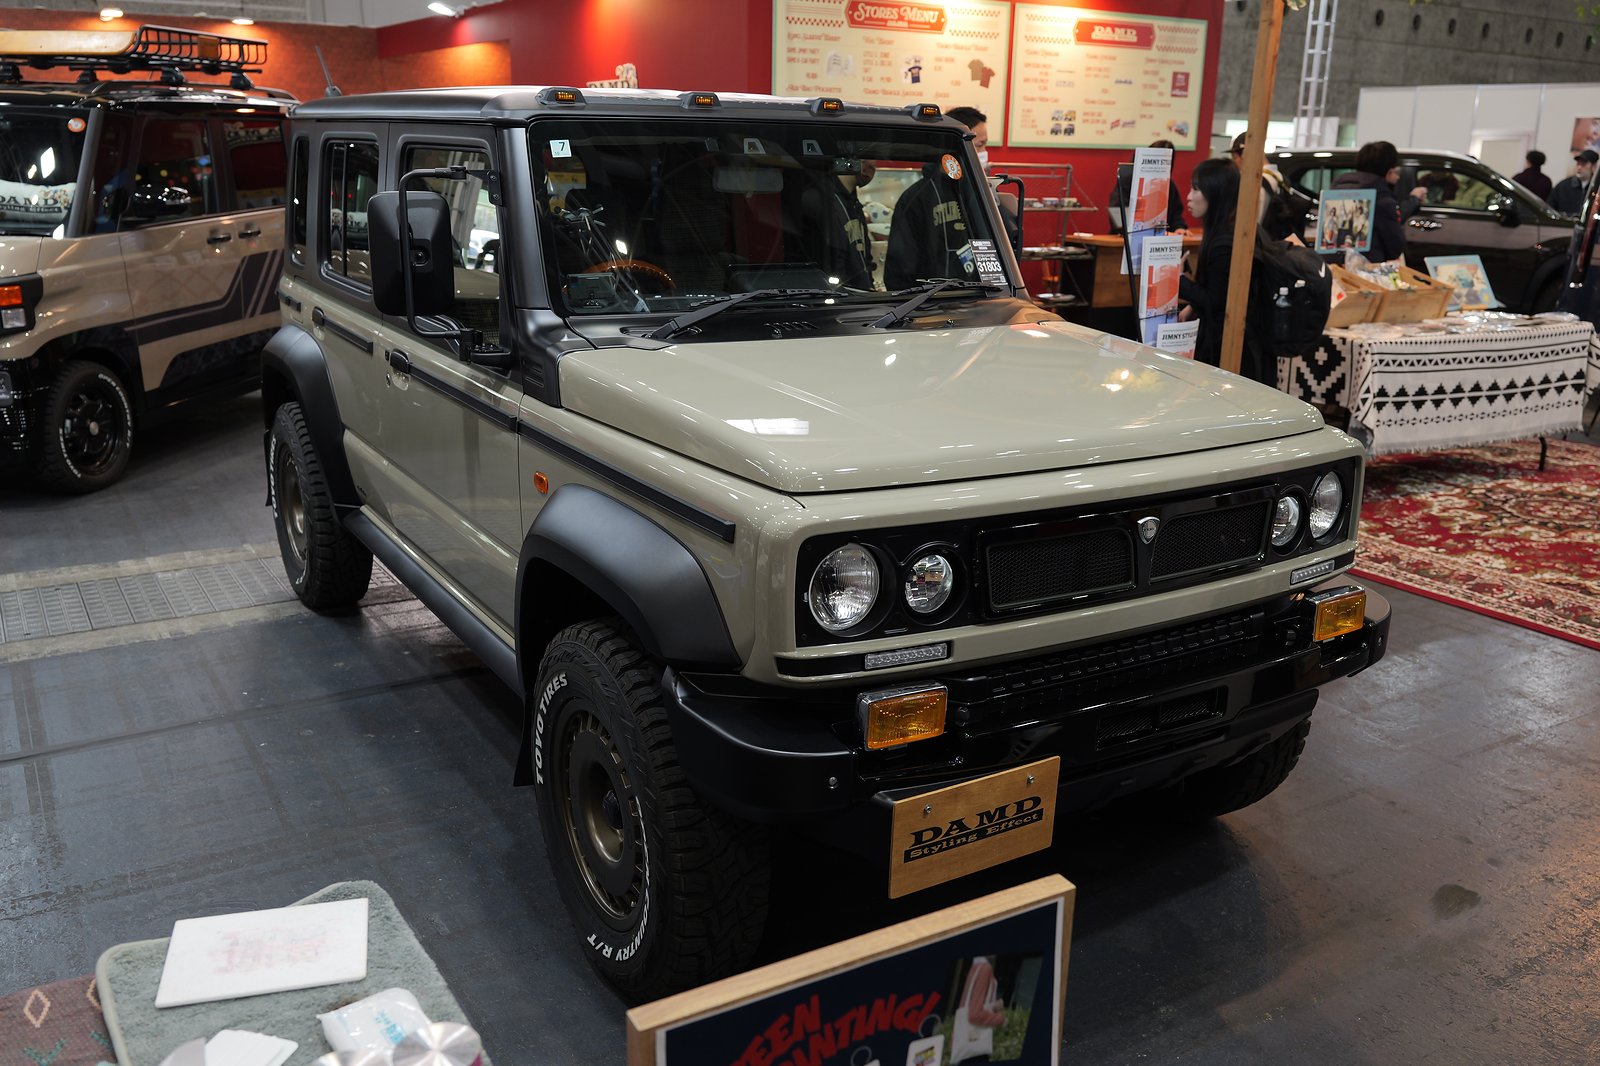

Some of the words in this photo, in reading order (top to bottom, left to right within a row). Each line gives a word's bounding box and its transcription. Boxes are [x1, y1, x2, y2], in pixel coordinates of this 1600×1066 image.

[854, 3, 899, 21] STORES
[900, 6, 940, 23] MENU
[558, 141, 565, 152] 7
[977, 261, 1002, 272] 31803
[534, 714, 546, 785] TOYO
[540, 672, 568, 715] TIRES
[910, 796, 1042, 848] DAMD
[910, 832, 978, 859] Styling
[986, 813, 1040, 836] Effect
[615, 888, 651, 961] COUNTRY
[586, 932, 614, 960] R/T
